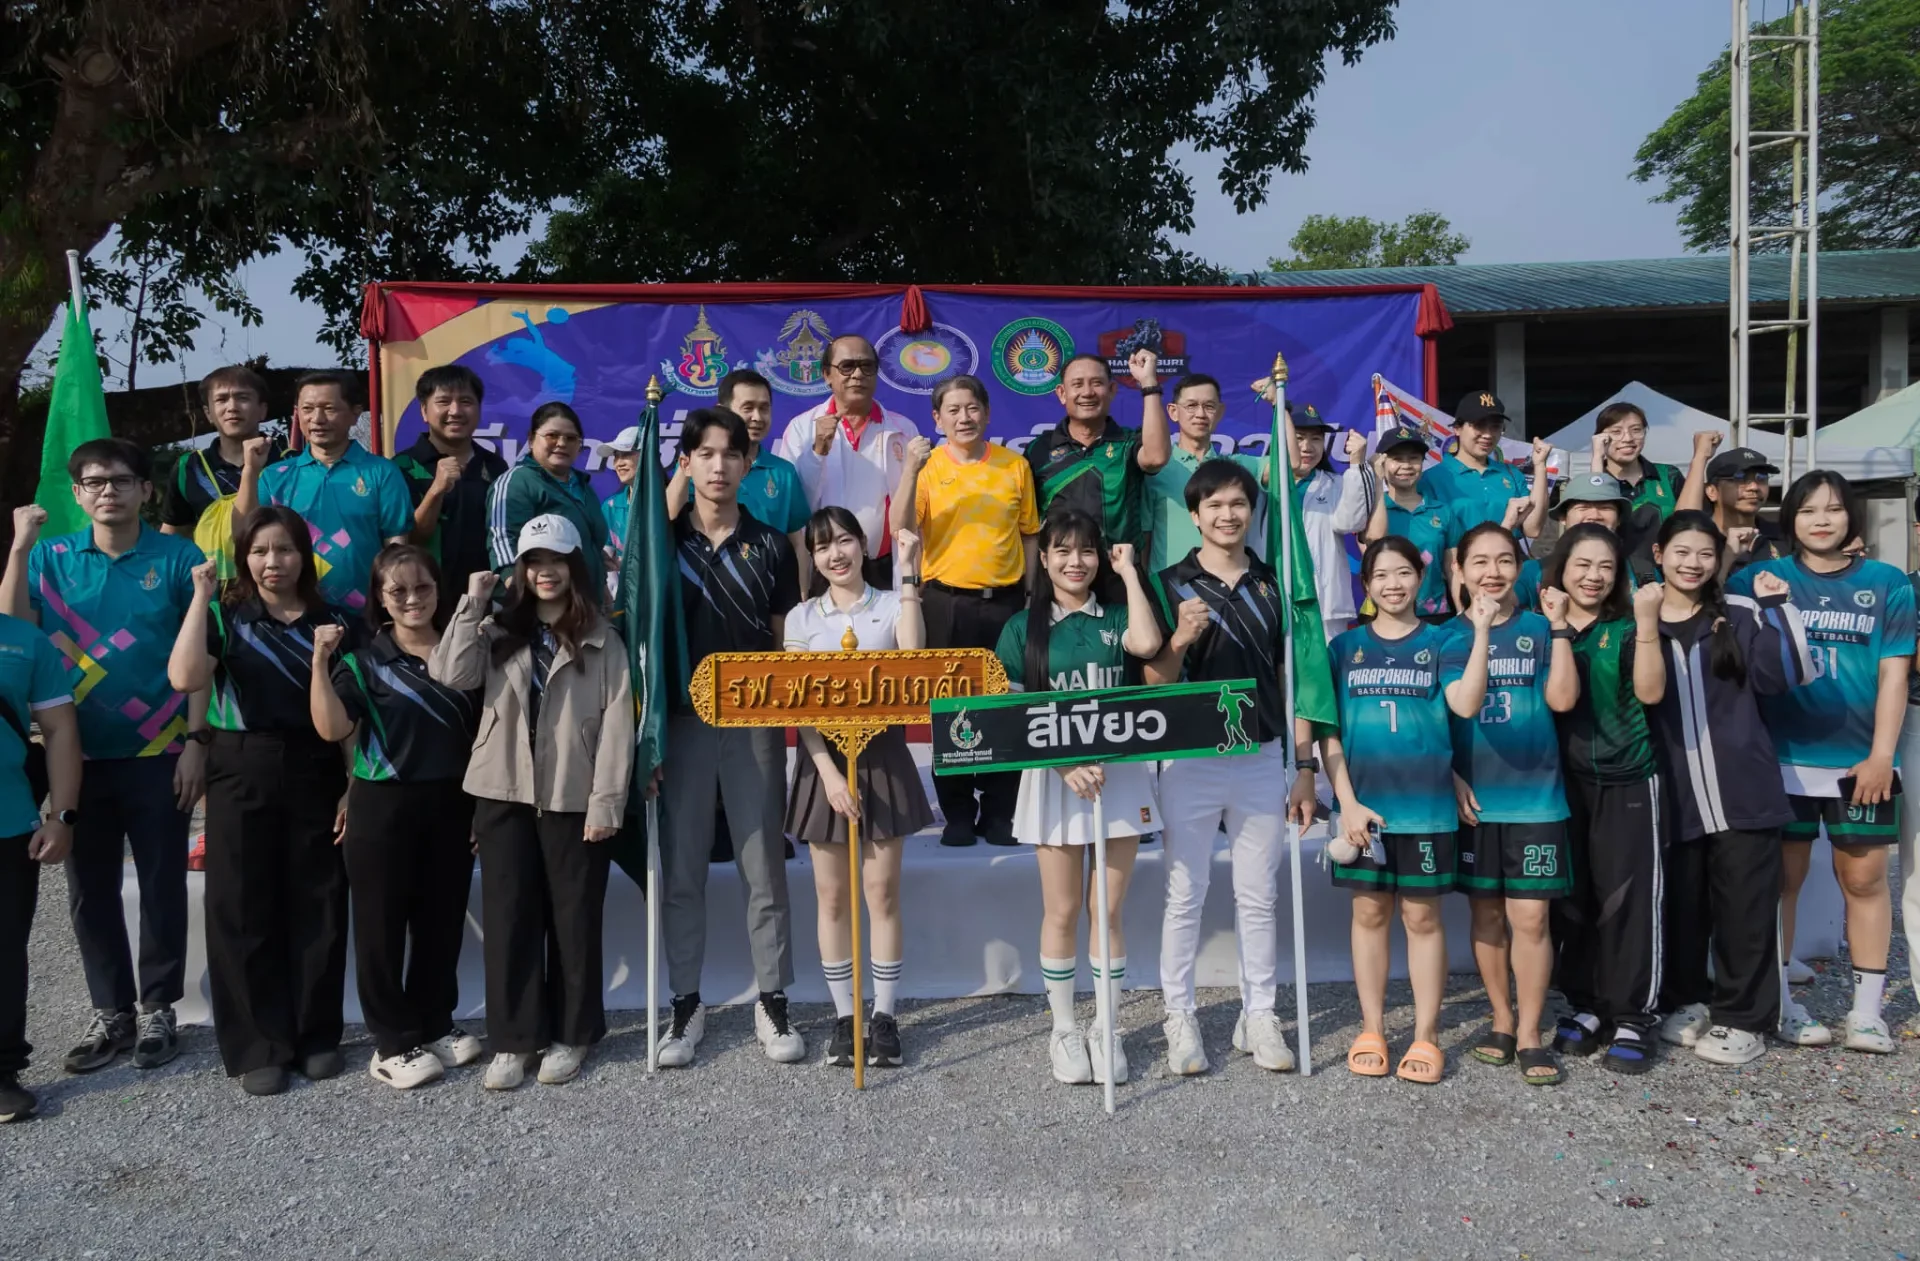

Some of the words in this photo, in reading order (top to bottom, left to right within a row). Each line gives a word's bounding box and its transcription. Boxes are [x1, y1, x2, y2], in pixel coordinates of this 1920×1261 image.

[1801, 610, 1875, 634] APOKKLAO
[1807, 631, 1858, 643] KETBALL
[727, 661, 972, 708] รพ.พระปกเกล้า
[1357, 687, 1417, 696] BASKETBALL
[1489, 678, 1525, 686] ETBALL
[1026, 699, 1167, 748] สีเขียว
[1380, 700, 1397, 733] 7
[1480, 691, 1511, 724] 23
[1523, 844, 1557, 876] 23
